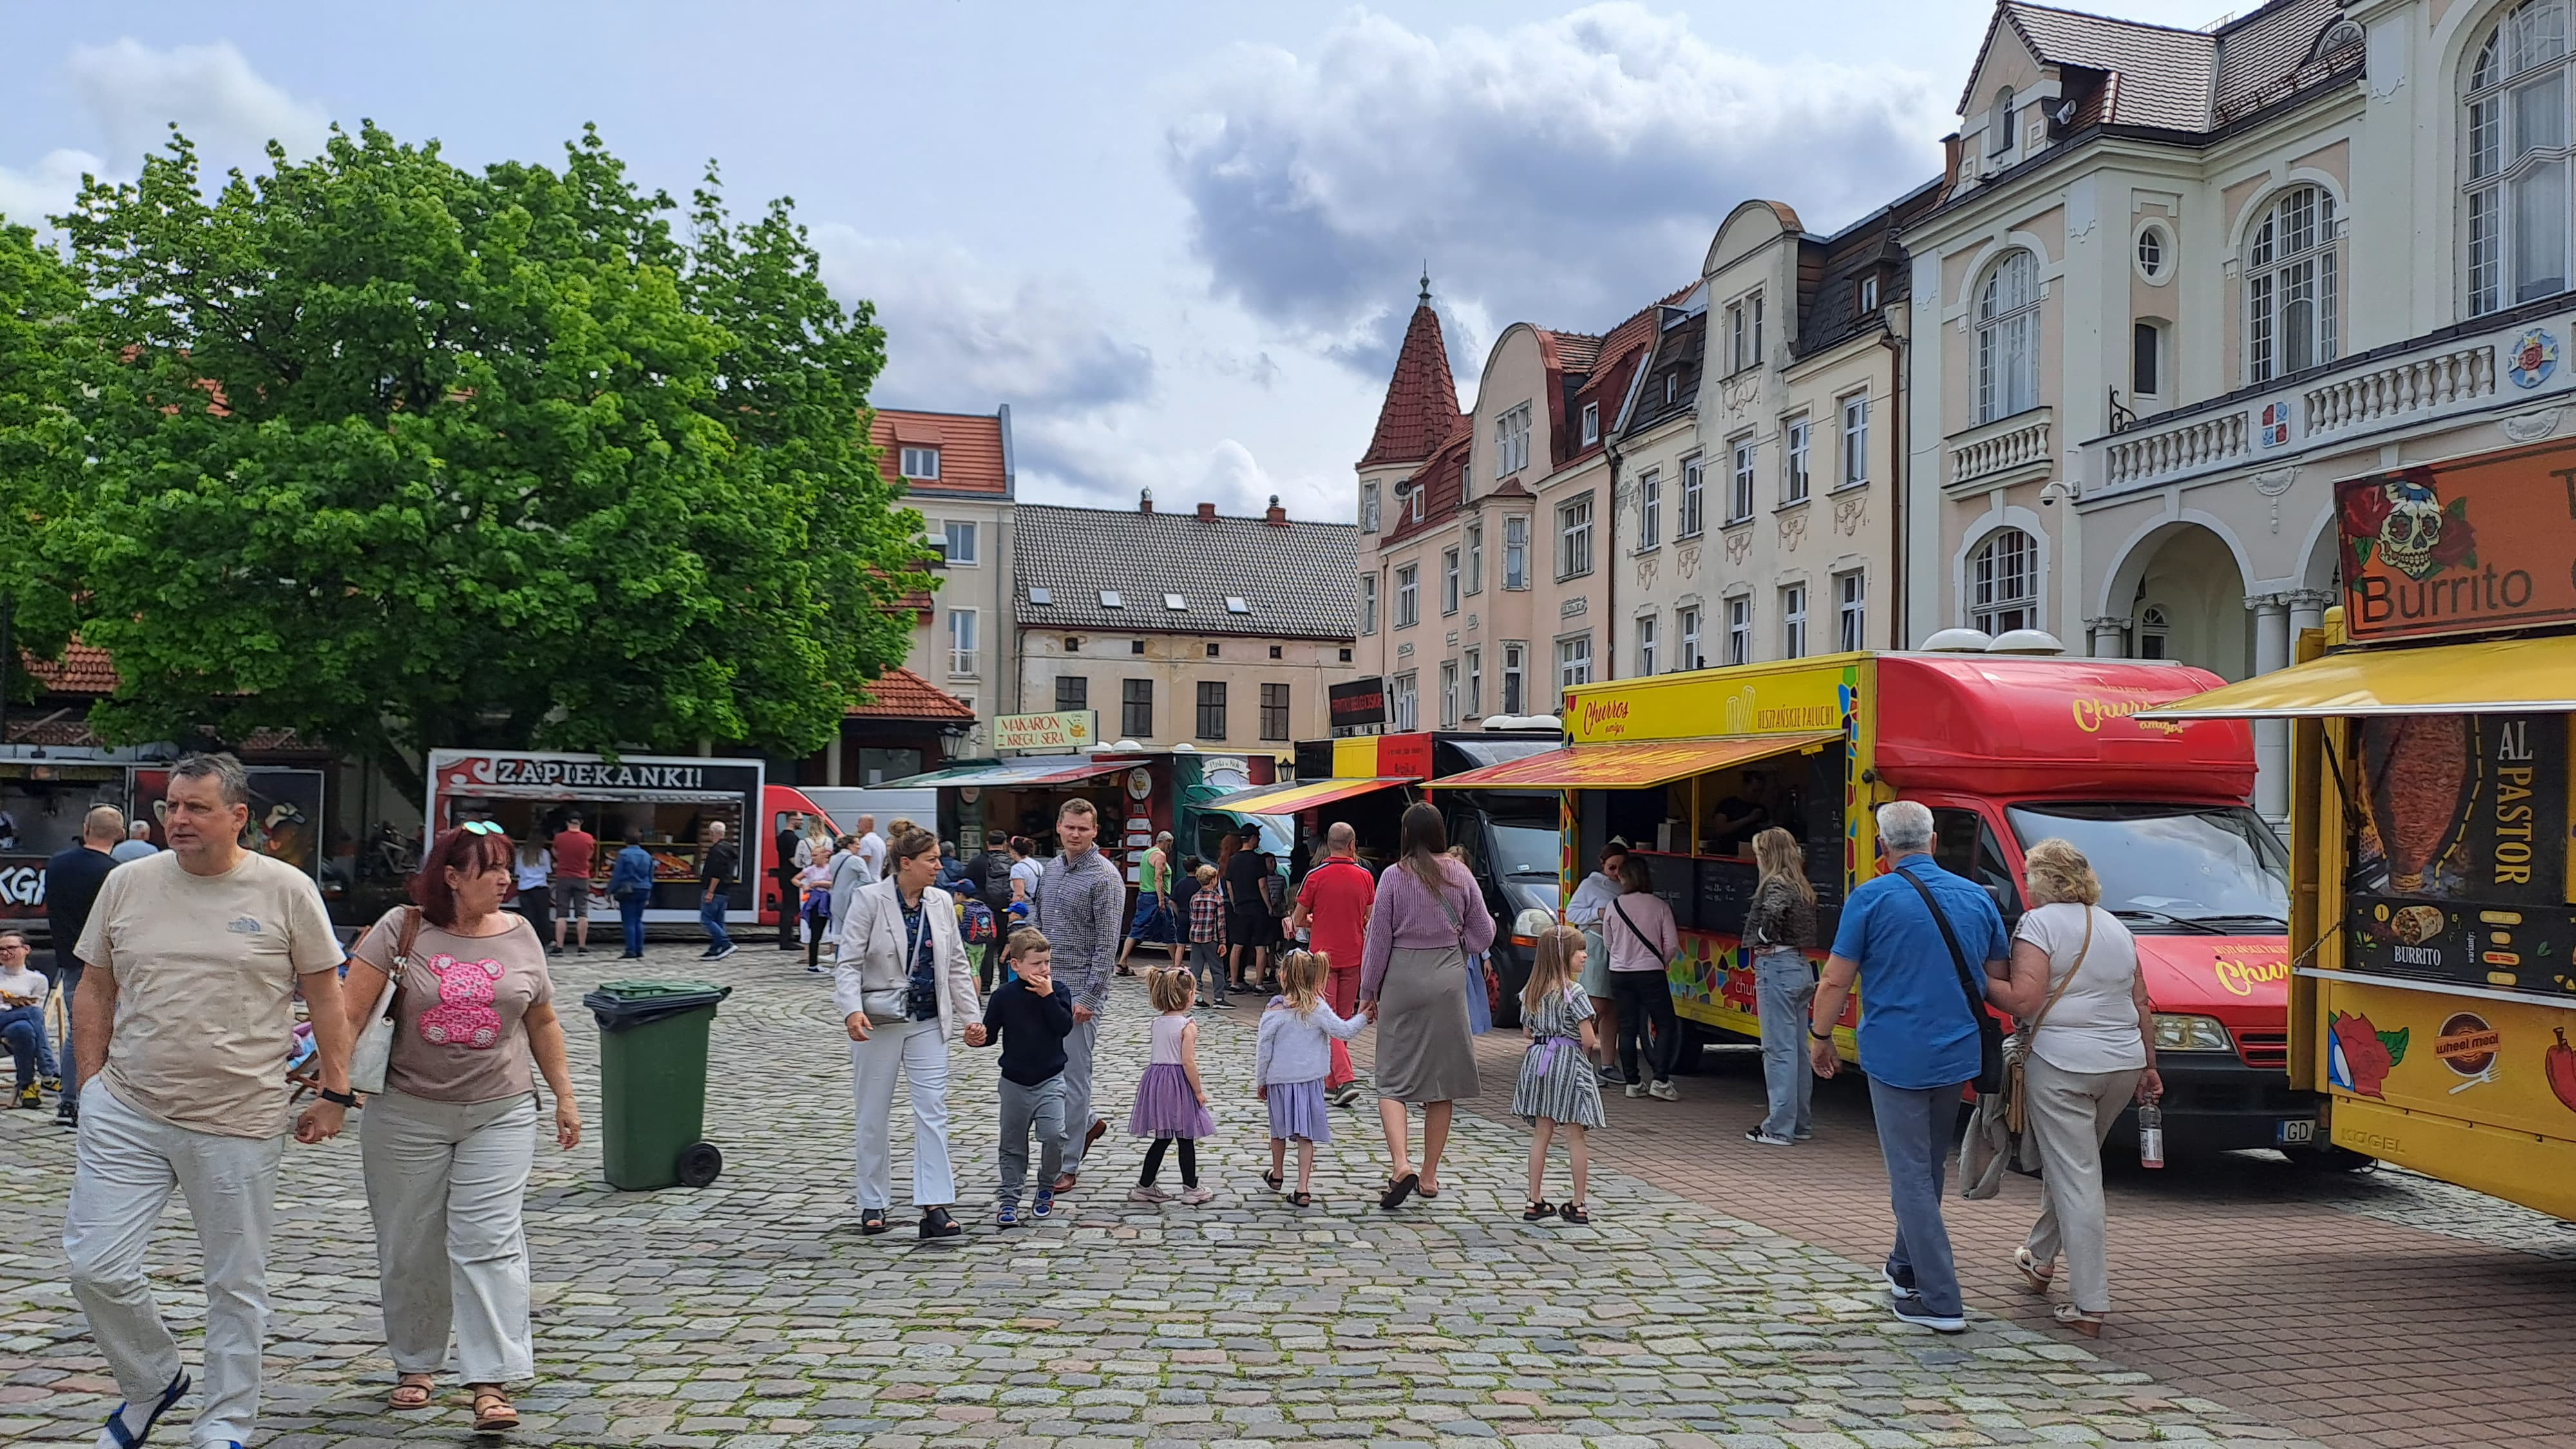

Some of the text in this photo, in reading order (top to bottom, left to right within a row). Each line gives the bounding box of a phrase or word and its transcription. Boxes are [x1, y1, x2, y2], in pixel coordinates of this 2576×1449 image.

[2362, 562, 2533, 623] Burrito
[1001, 715, 1060, 732] MAKARON
[1584, 699, 1629, 736] Churros
[1803, 705, 1835, 727] PALUCHY
[2072, 698, 2154, 733] Churr
[2139, 721, 2184, 735] amigos
[998, 734, 1005, 747] Z
[1041, 732, 1065, 745] SERA
[2497, 720, 2534, 761] AL
[497, 761, 703, 789] ZAPIEKANKI!
[2494, 766, 2534, 885] PASTOR
[2394, 945, 2441, 966] BURRITO
[2215, 959, 2289, 996] Chur
[2436, 1033, 2499, 1054] wheel meal
